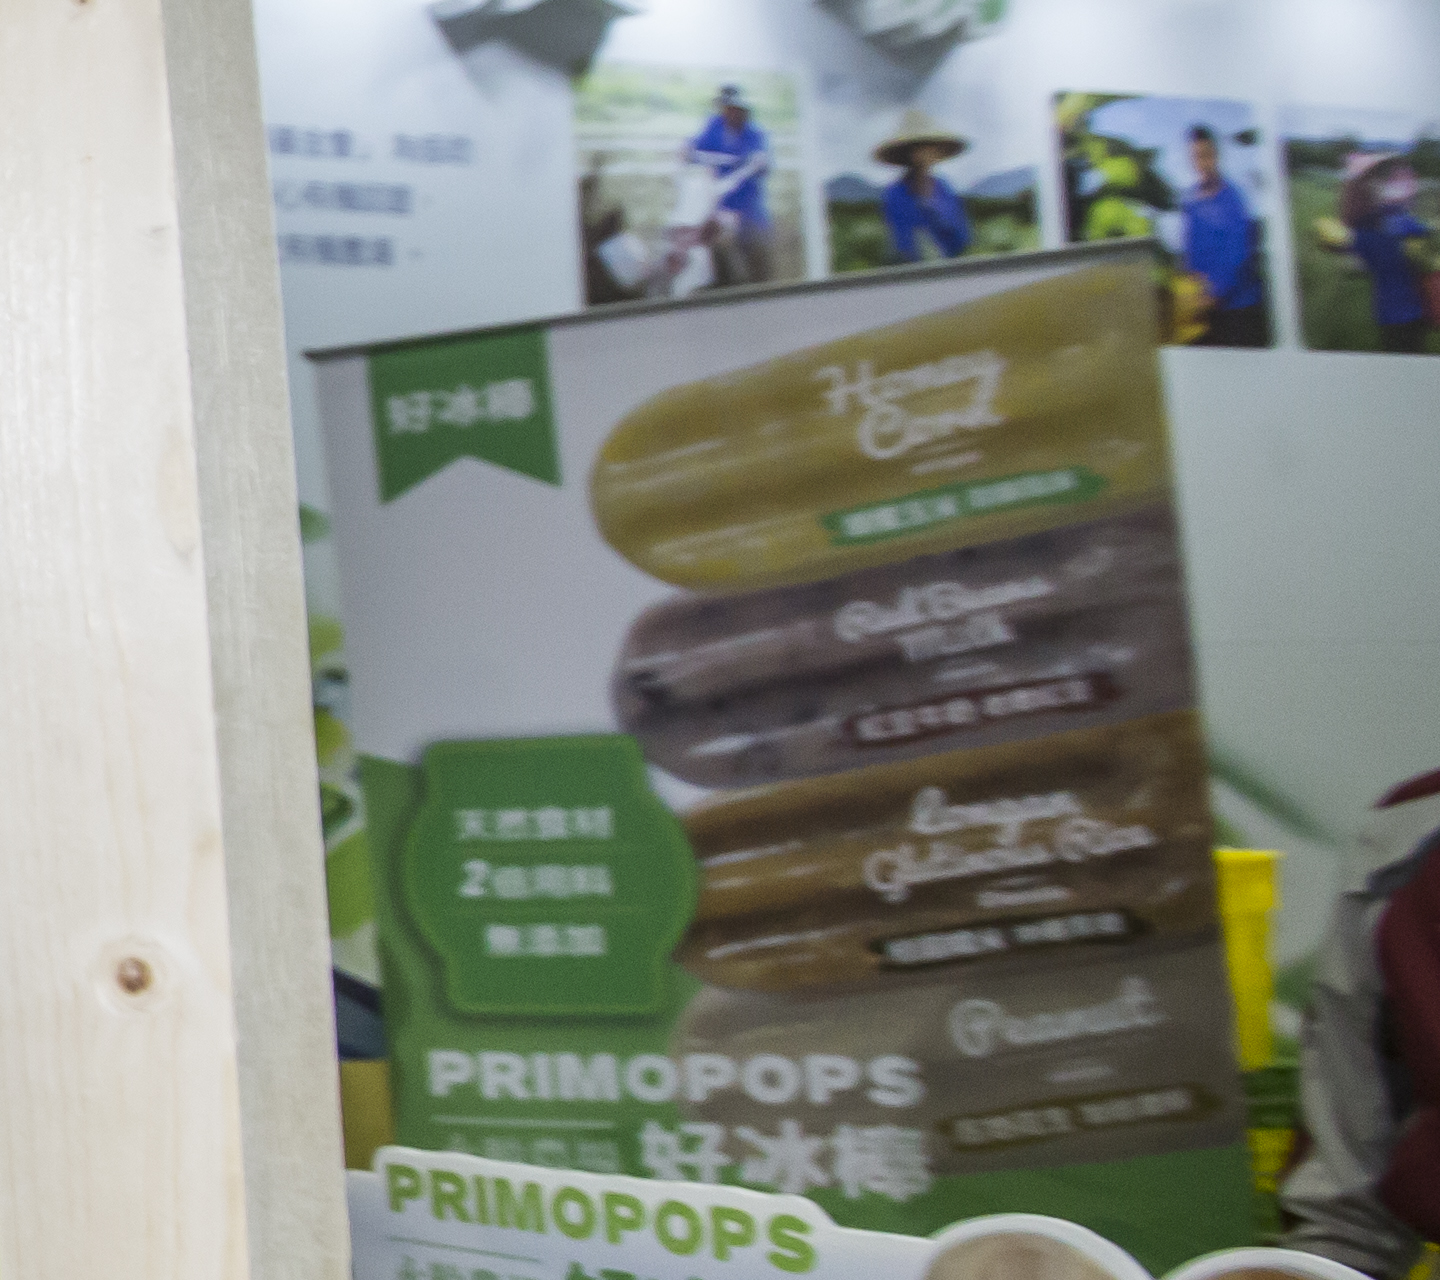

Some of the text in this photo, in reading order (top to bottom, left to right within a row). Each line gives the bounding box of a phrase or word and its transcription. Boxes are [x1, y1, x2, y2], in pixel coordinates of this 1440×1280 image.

[428, 1050, 926, 1108] PRIMOPOPS
[639, 1121, 934, 1203] 好冰棒
[385, 1164, 820, 1273] PRIMOPOPS
